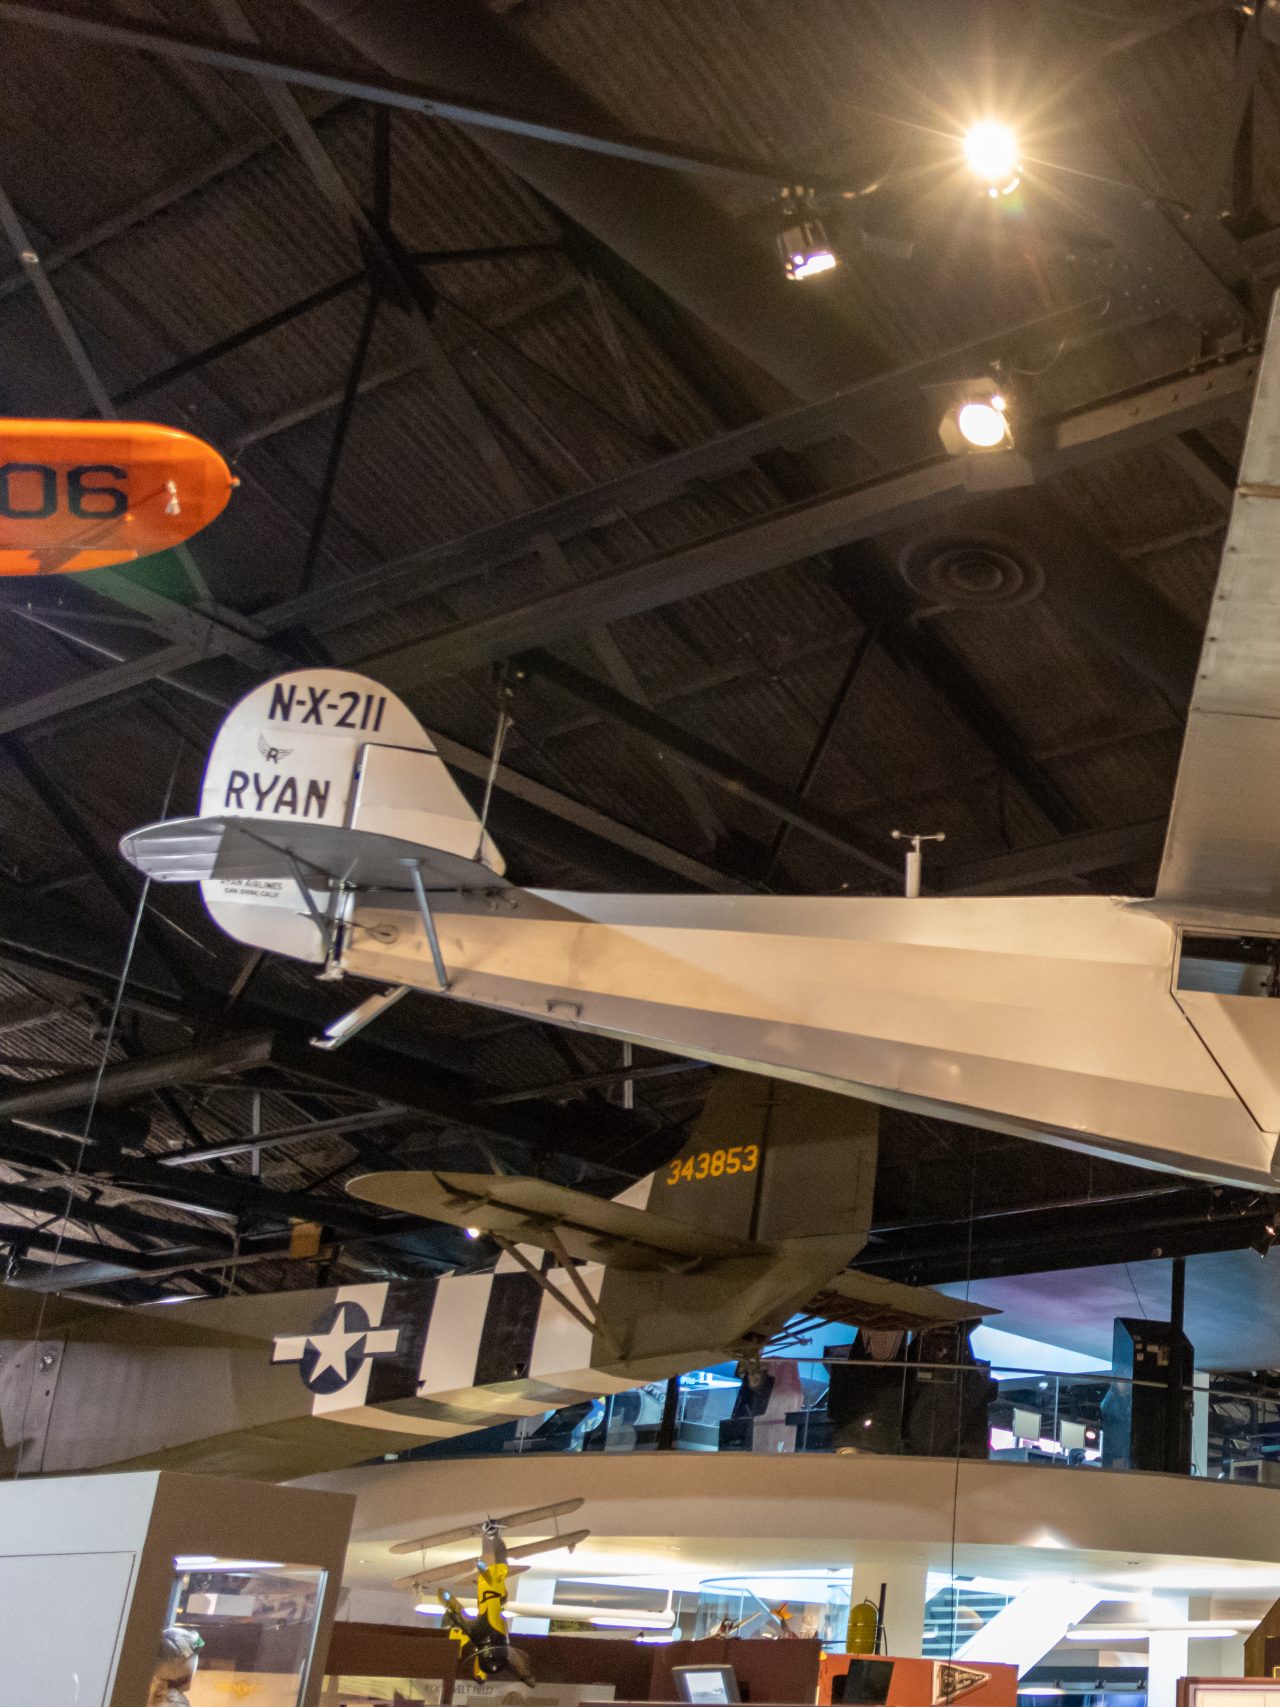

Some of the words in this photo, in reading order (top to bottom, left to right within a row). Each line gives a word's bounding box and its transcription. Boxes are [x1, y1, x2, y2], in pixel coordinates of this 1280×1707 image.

[0, 462, 128, 519] 06
[268, 683, 387, 732] N-X-211
[224, 770, 331, 818] RYAN
[667, 1144, 759, 1186] 343853
